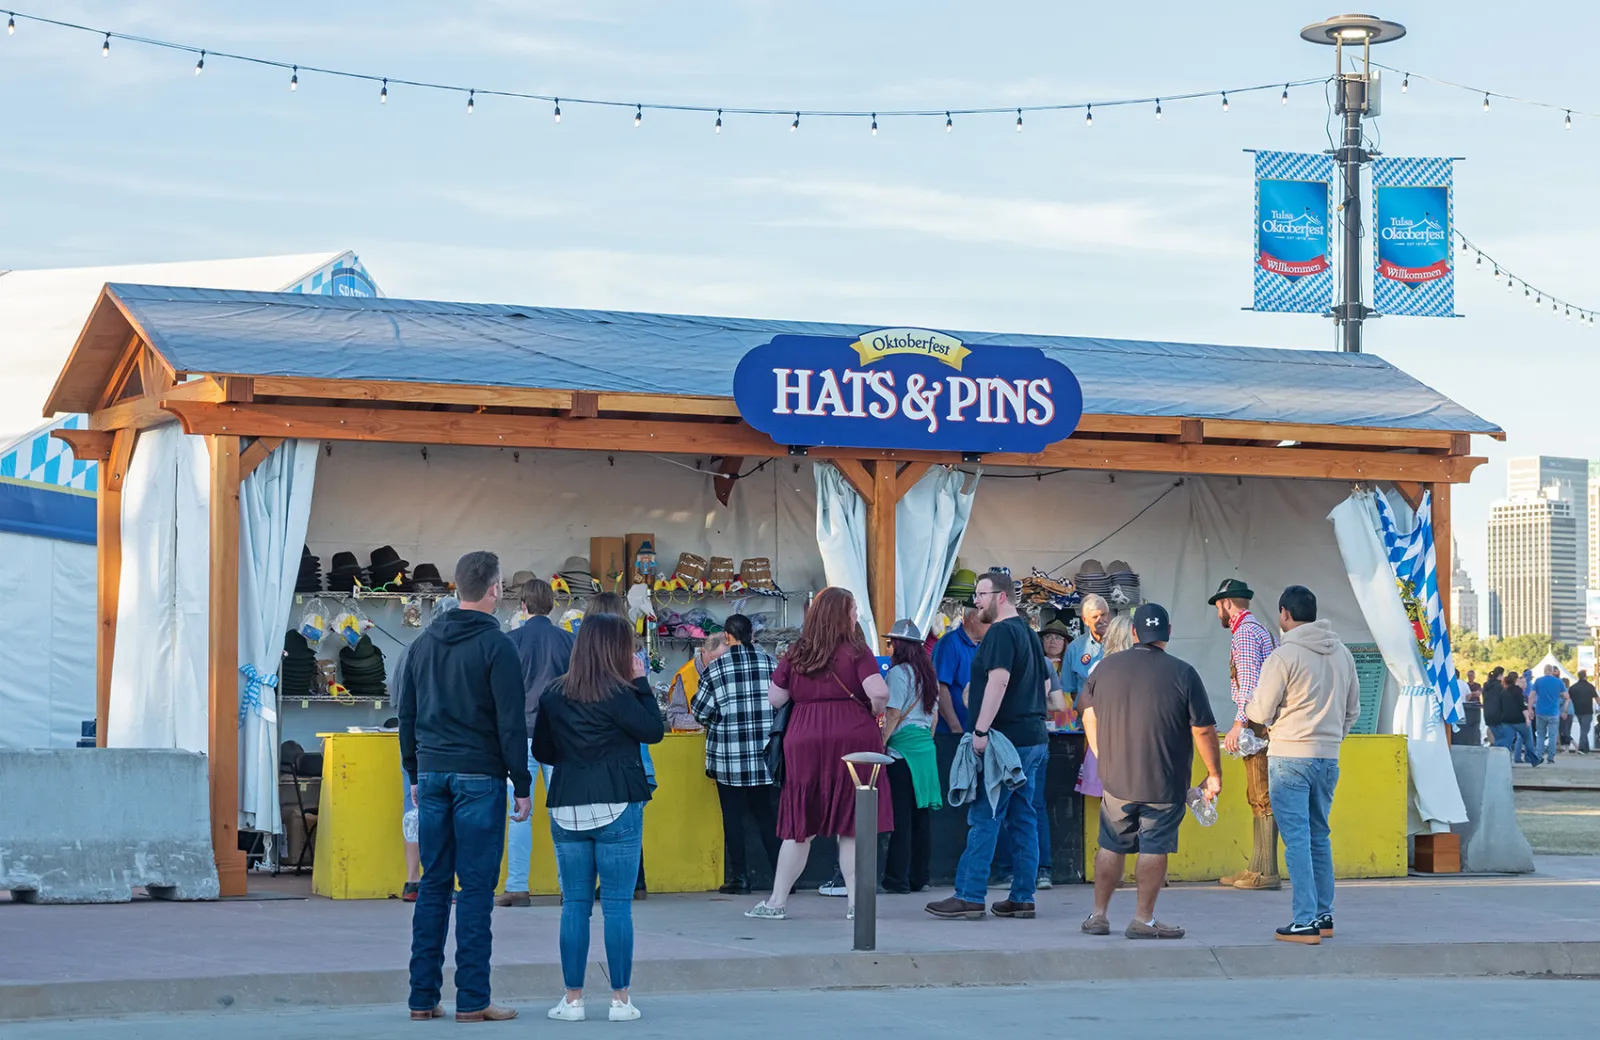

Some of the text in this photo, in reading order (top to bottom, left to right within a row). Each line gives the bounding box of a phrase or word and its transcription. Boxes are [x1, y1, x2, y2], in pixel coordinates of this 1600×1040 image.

[1271, 210, 1294, 220] Tulsa
[1390, 216, 1413, 226] Tulsa
[1262, 219, 1325, 237] Oktoberfest
[1381, 226, 1445, 243] Oktoberfest
[1267, 259, 1321, 273] Willkommen
[1387, 266, 1442, 280] Willkommen
[339, 284, 369, 297] SPAT
[872, 333, 951, 356] Oktoberfest
[772, 368, 1056, 434] HATS & PINS
